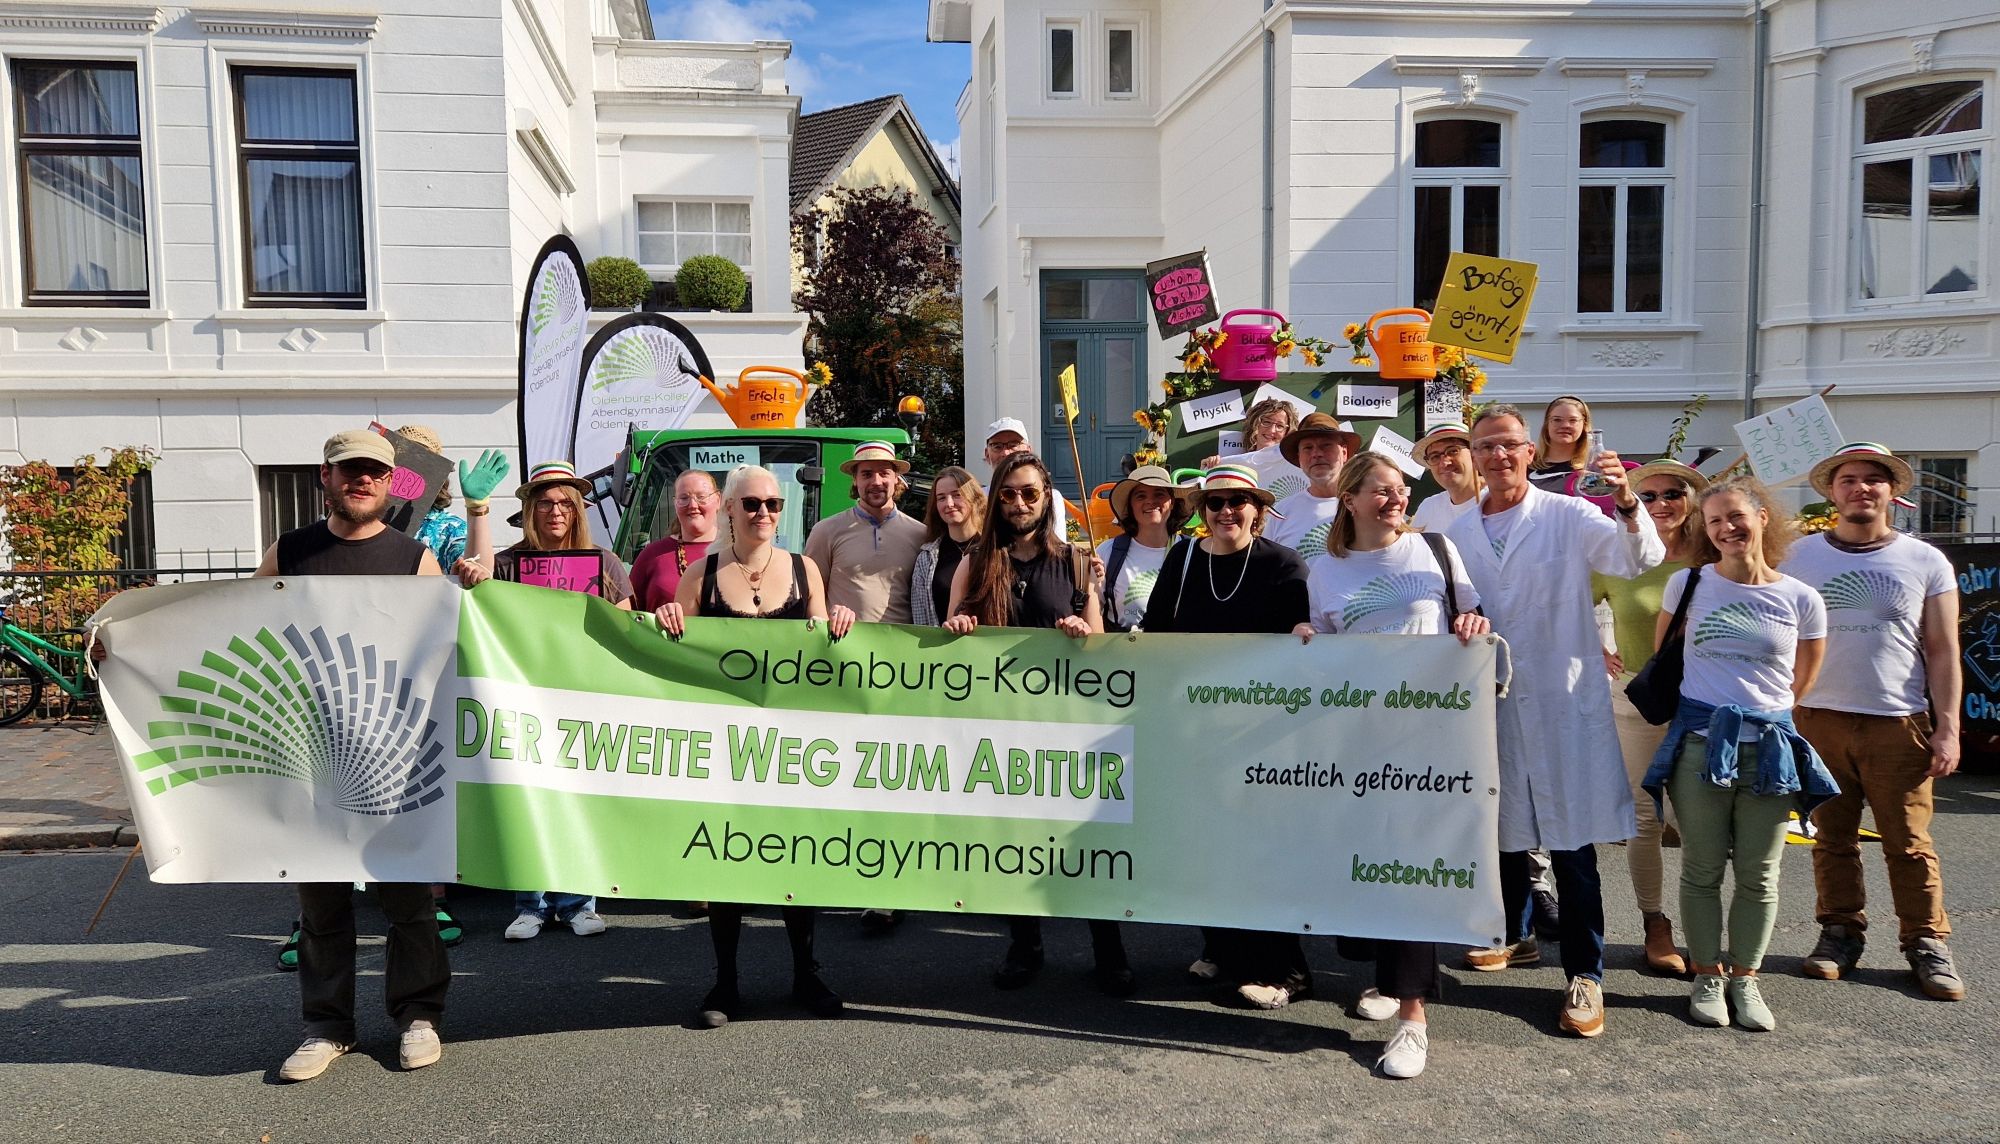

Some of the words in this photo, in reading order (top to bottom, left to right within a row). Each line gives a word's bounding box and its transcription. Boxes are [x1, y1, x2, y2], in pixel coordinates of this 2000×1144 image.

[1459, 266, 1524, 309] Bafög
[1450, 304, 1520, 344] gönnt!
[1240, 333, 1270, 345] Bildu
[1399, 331, 1428, 344] Erfol
[591, 391, 689, 405] Oldenburg-Kolleg
[748, 388, 785, 403] Erfolg
[1342, 395, 1392, 409] Biologie
[750, 411, 784, 422] ernten
[1192, 401, 1232, 421] Physik
[1223, 439, 1243, 448] Fran
[1380, 436, 1413, 460] Geschich
[695, 450, 745, 464] Mathe
[521, 557, 563, 575] DEIN
[718, 648, 1136, 709] Oldenburg-Kolleg
[1187, 680, 1313, 715] vormittags
[1320, 680, 1377, 708] oder
[1384, 681, 1472, 711] abends
[455, 697, 542, 764] DER
[554, 718, 712, 779] ZWEITE
[727, 724, 841, 788] WEG
[853, 741, 950, 792] ZUM
[963, 738, 1126, 800] ABITUR
[1244, 760, 1345, 788] staatlich
[1352, 762, 1474, 798] gefördert
[682, 820, 1134, 881] Abendgymnasium
[1351, 853, 1477, 890] kostenfrei
